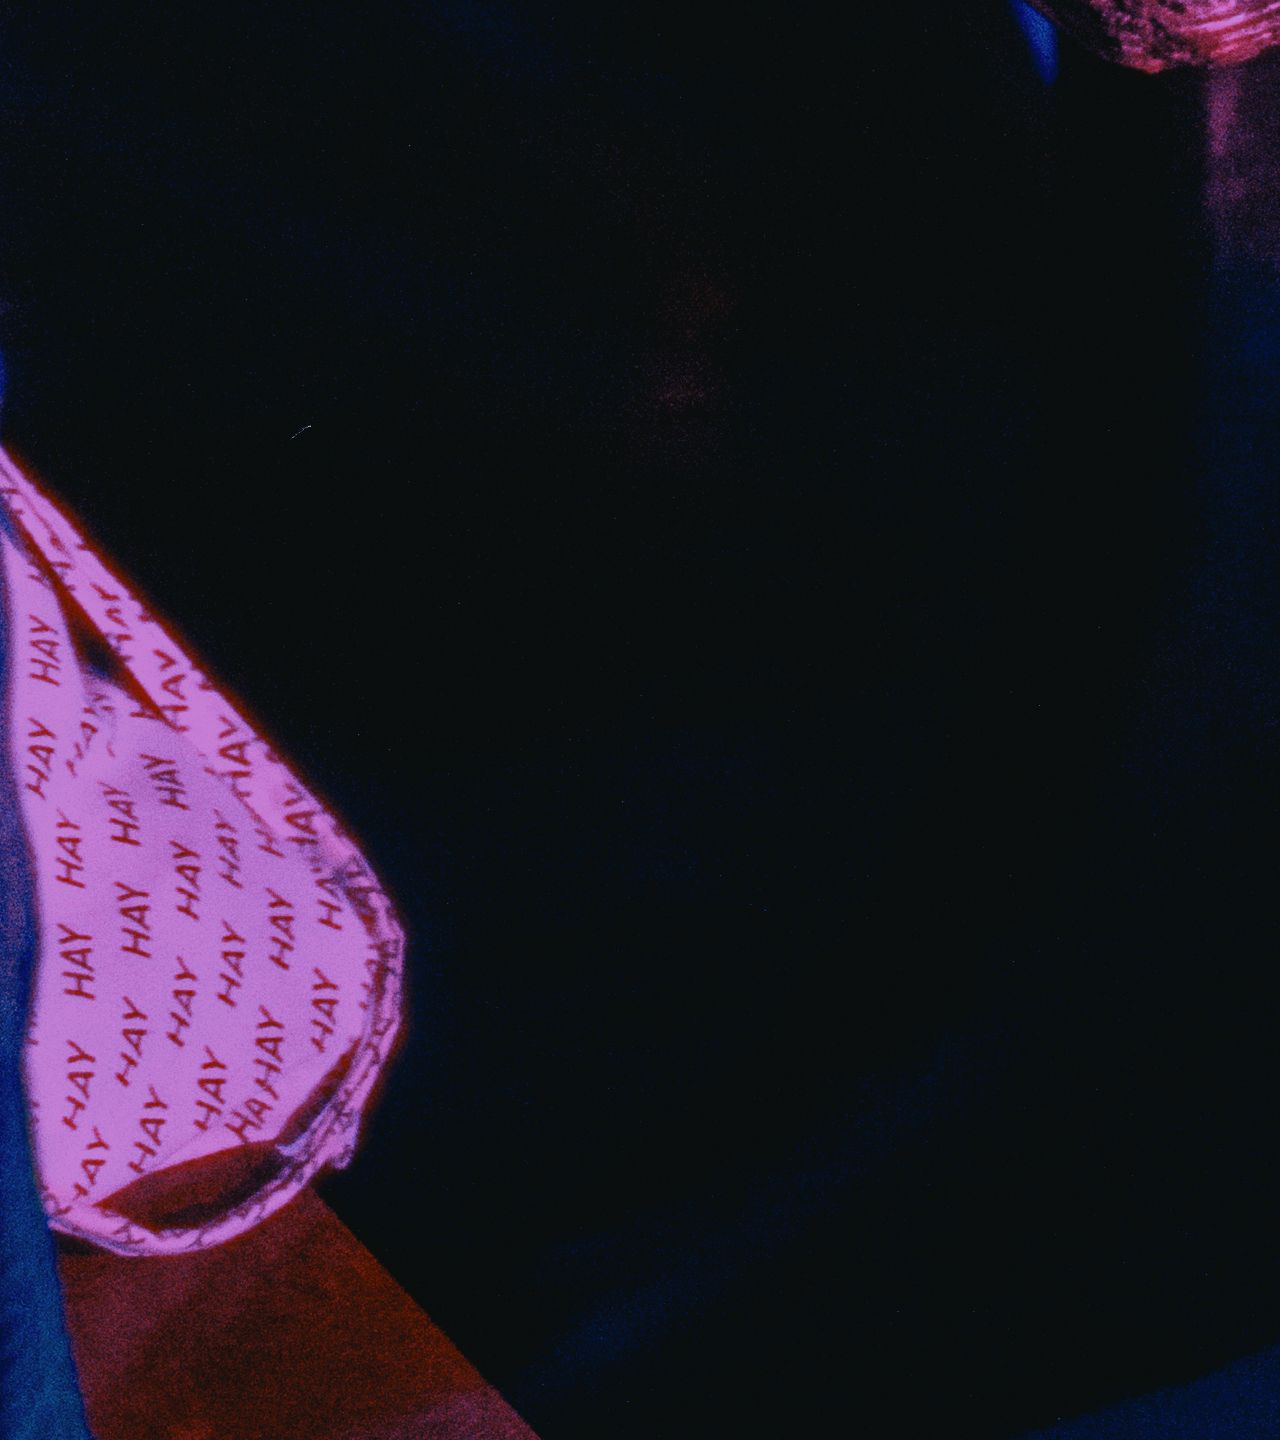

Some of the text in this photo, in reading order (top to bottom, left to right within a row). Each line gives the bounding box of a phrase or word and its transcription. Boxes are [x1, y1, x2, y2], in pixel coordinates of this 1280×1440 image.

[29, 613, 61, 687] HAY
[26, 717, 57, 800] HAY
[139, 753, 188, 811] HAY
[55, 808, 85, 889] HAY
[96, 780, 141, 847] HAY
[214, 808, 241, 889] HAY
[114, 881, 152, 959] HAY
[170, 840, 201, 921] HAY
[56, 922, 95, 1001] HAY
[218, 920, 246, 1008] HAY
[266, 886, 295, 971] HAY
[116, 995, 149, 1088] HAY
[166, 956, 199, 1048] HAY
[310, 967, 340, 1053] HAY
[62, 1039, 97, 1131] HAY
[193, 1045, 229, 1132] HAY
[254, 1004, 286, 1101] HAY
[127, 1085, 169, 1174] HAY
[224, 1098, 273, 1145] HA
